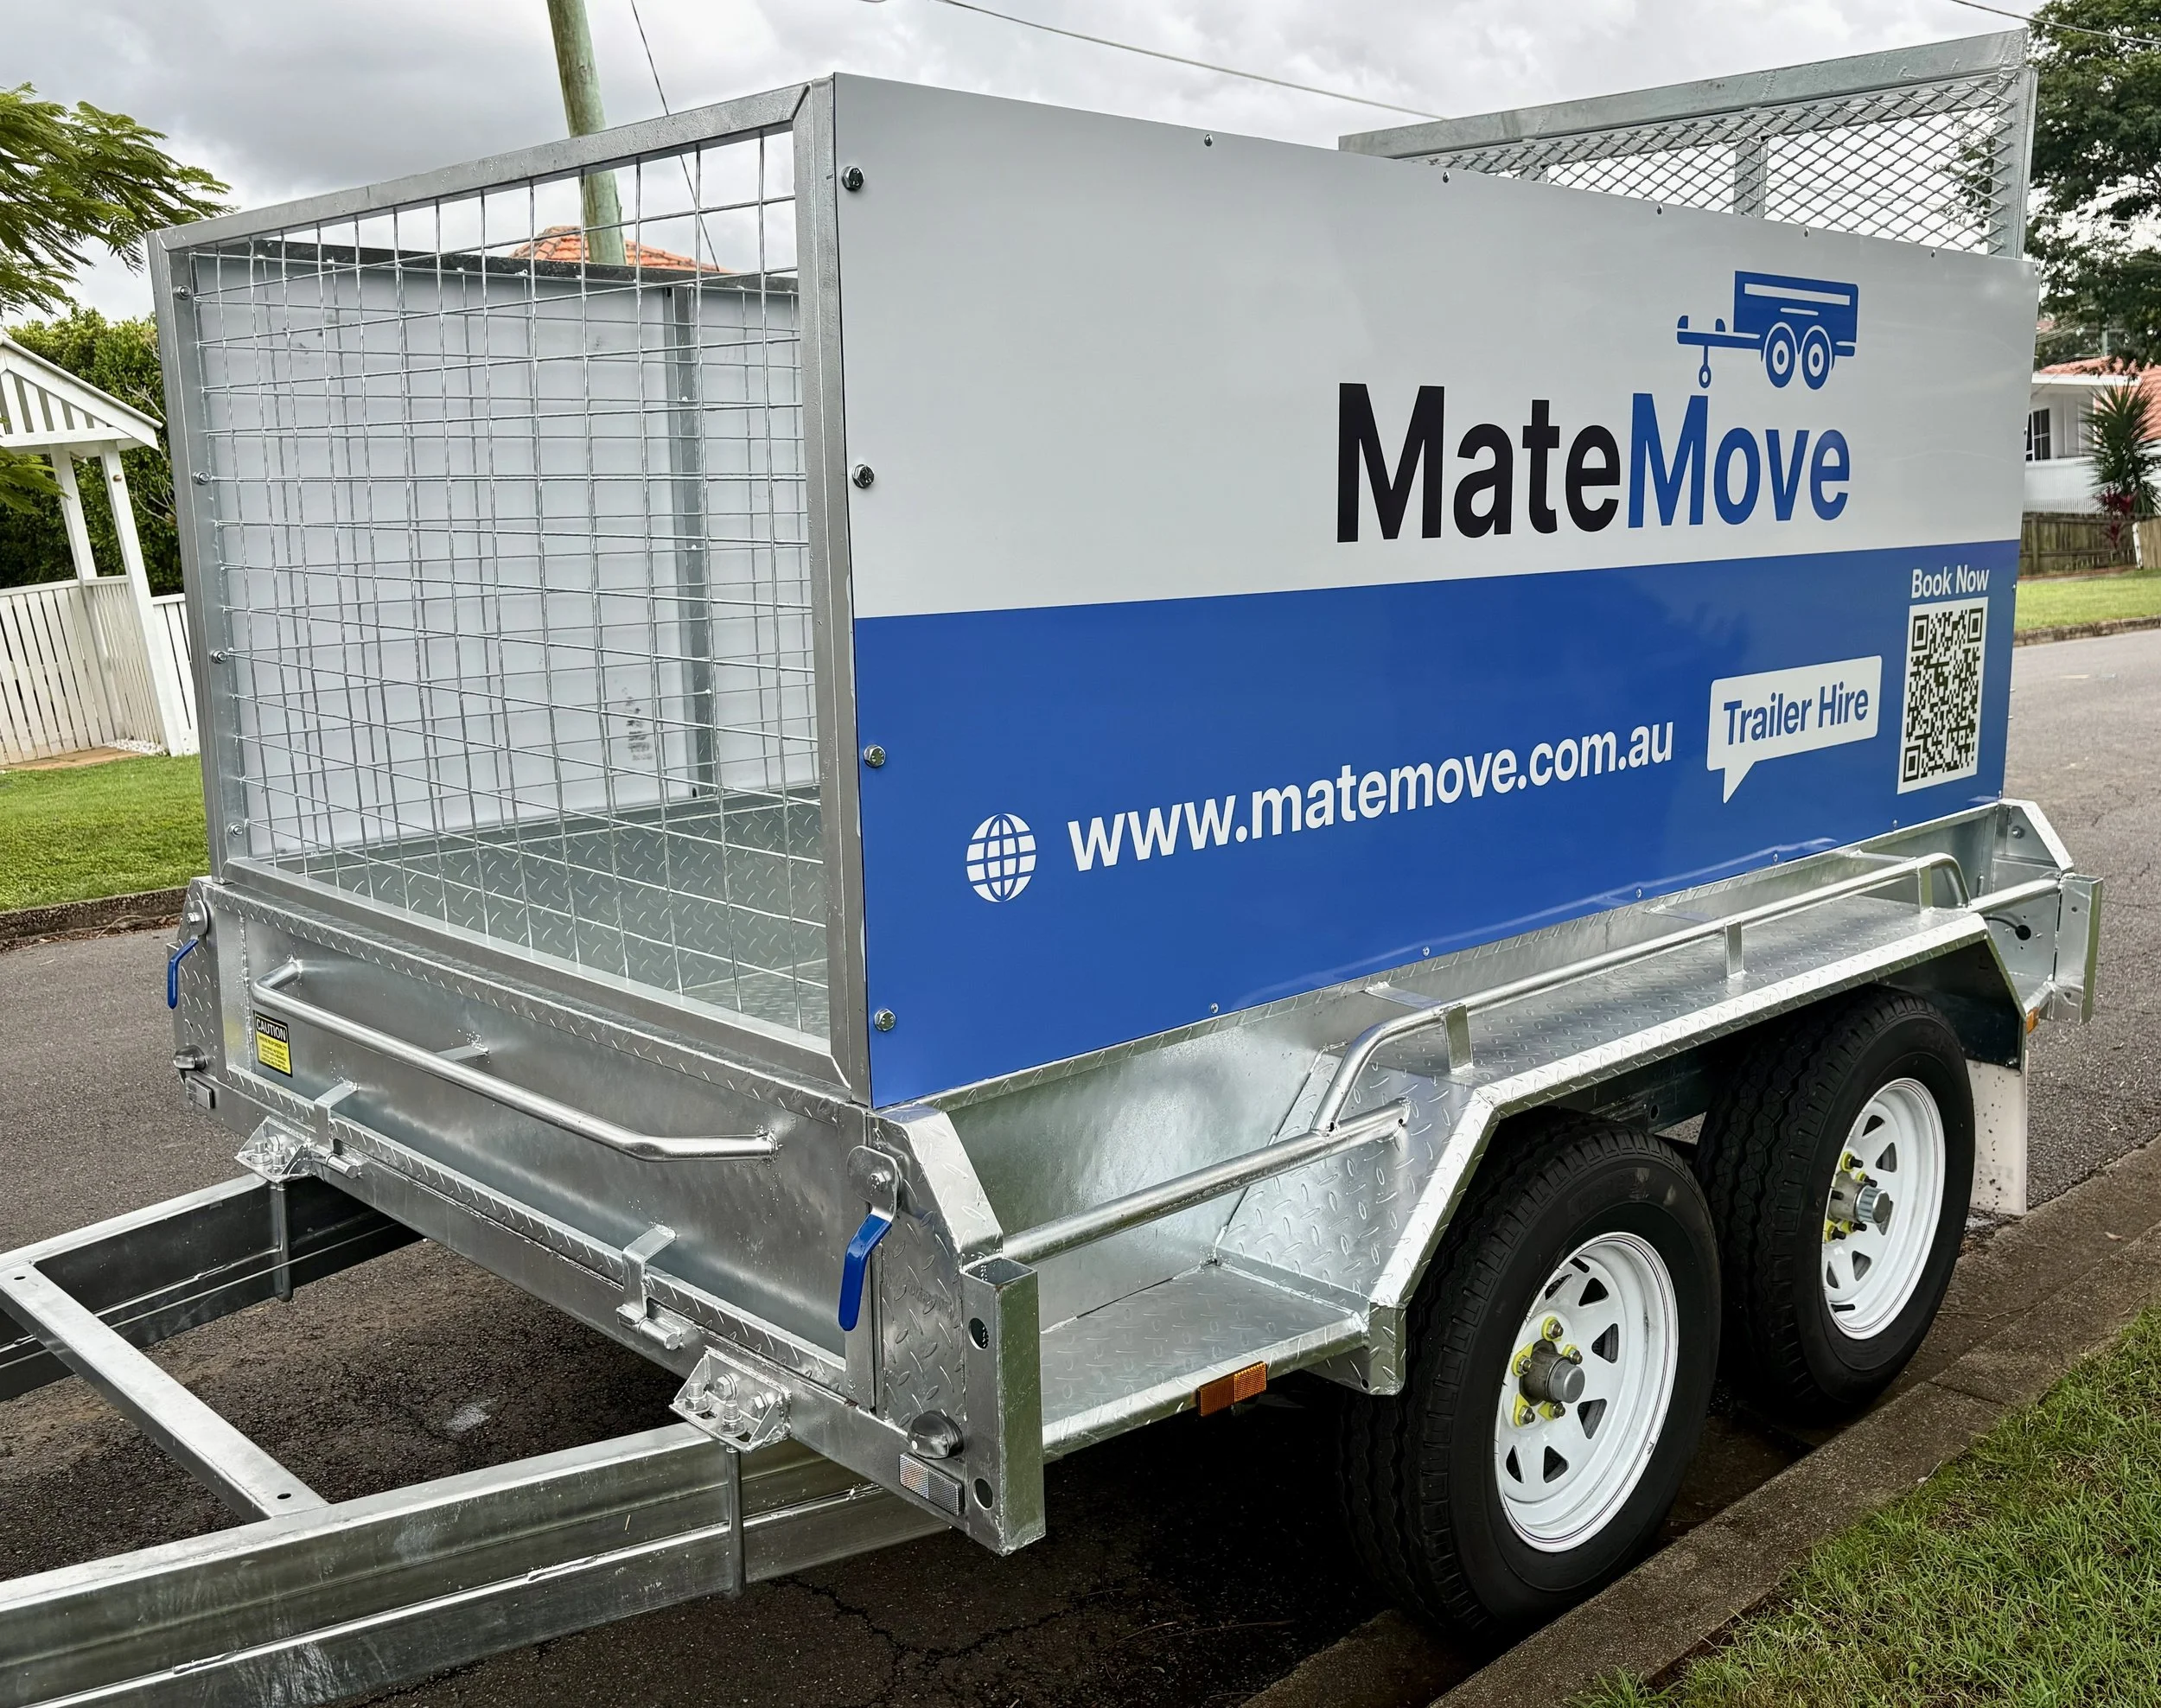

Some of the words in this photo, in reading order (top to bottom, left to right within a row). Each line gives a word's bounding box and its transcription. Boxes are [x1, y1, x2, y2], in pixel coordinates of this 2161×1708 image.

[1336, 382, 1851, 544] MateMove
[1910, 566, 1953, 599] Book
[1955, 564, 1990, 594] Now
[1723, 691, 1813, 746] Trailer
[1818, 680, 1869, 729] Hire
[1067, 721, 1674, 872] www.matemove.com.au
[256, 1018, 287, 1042] CAUTION
